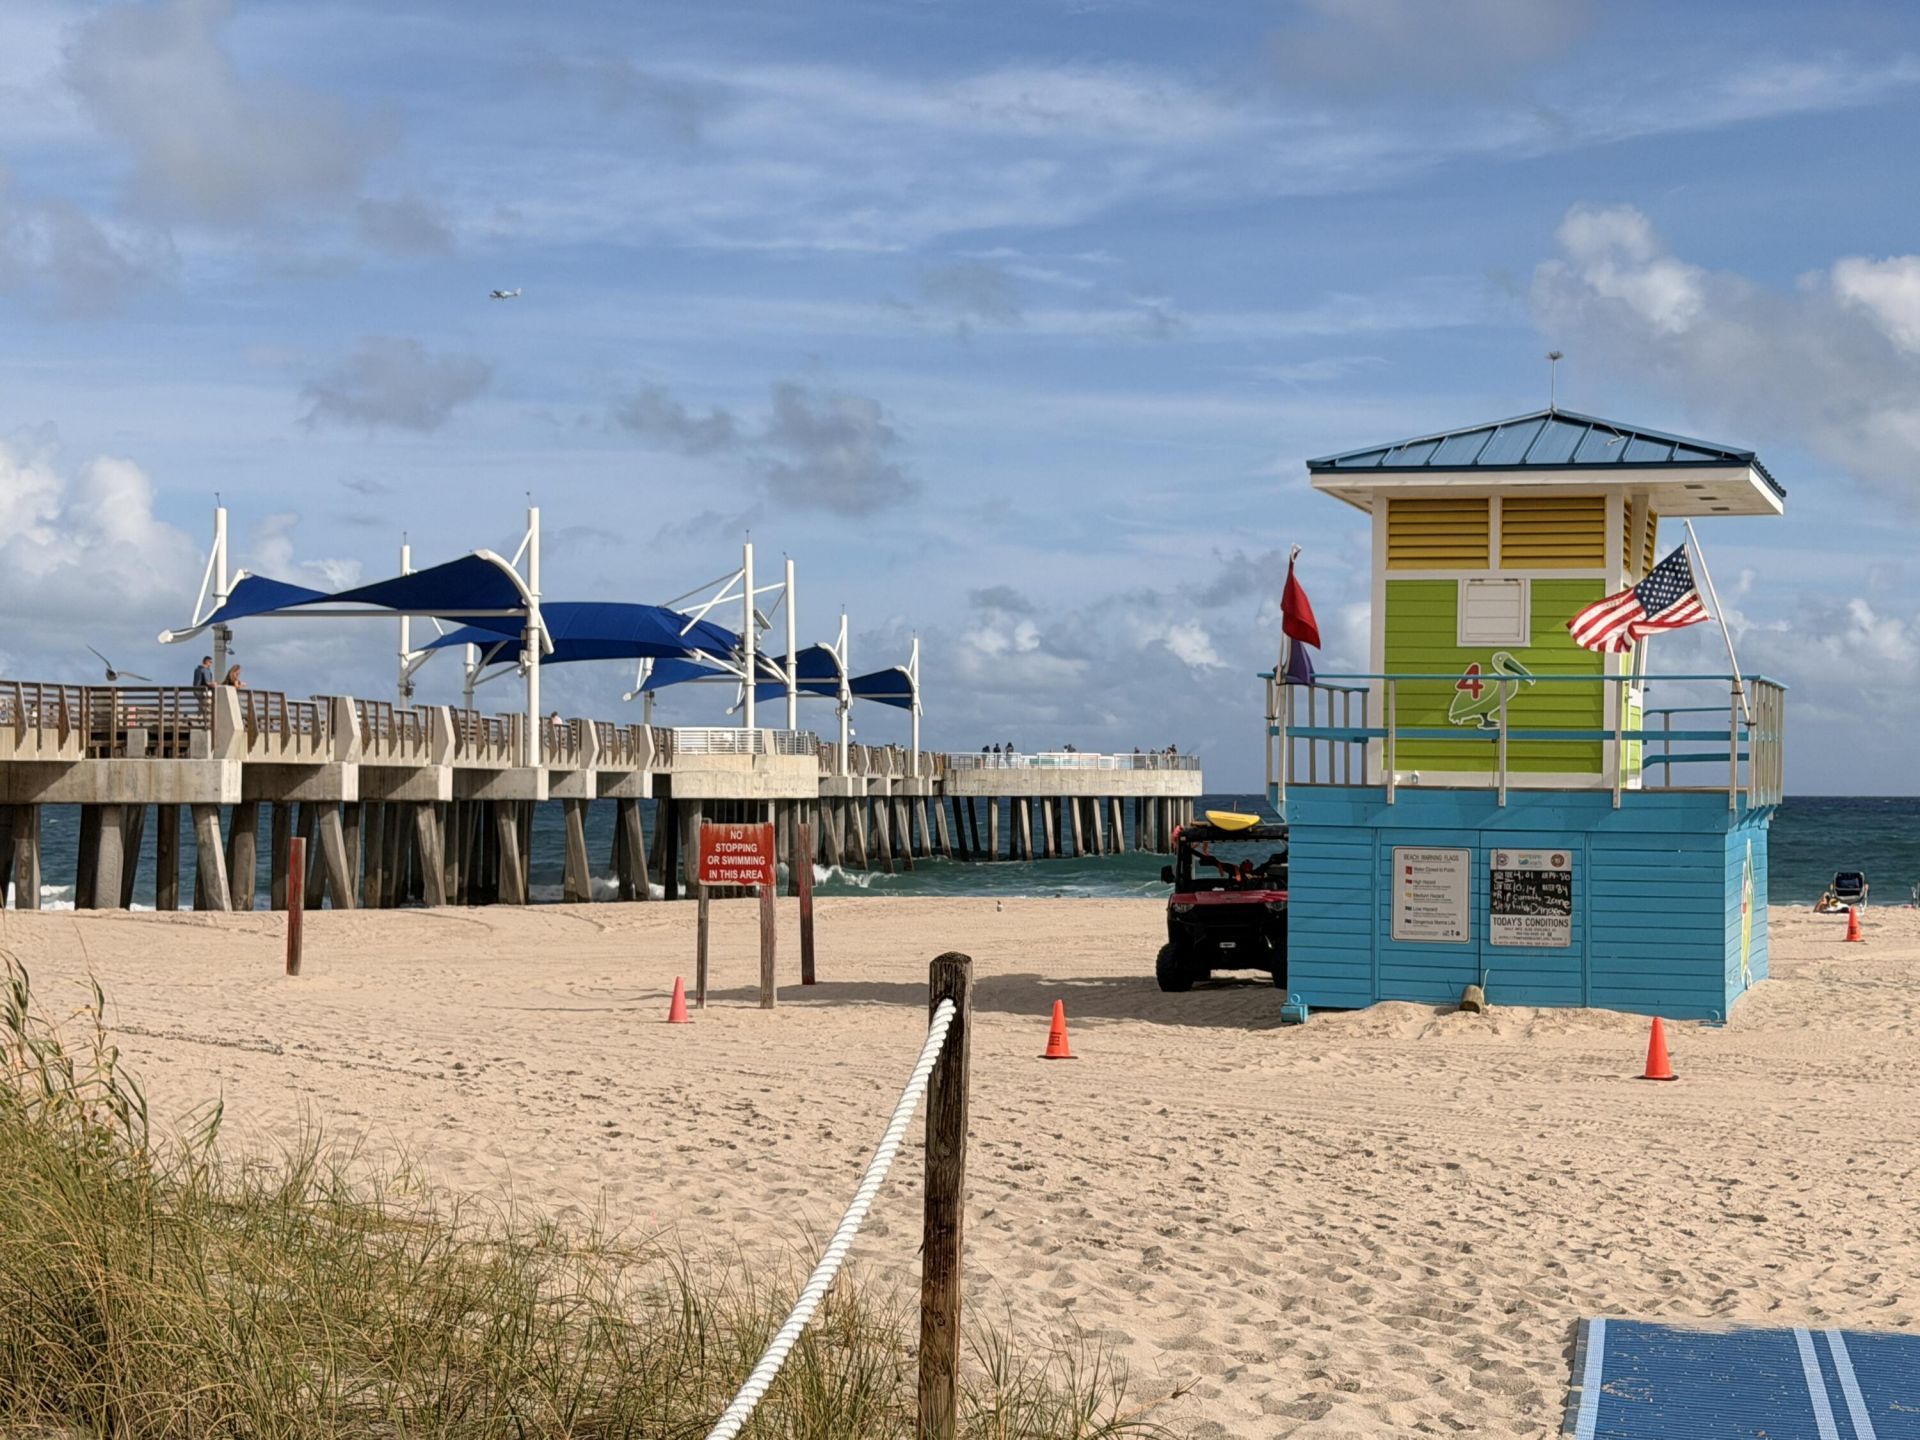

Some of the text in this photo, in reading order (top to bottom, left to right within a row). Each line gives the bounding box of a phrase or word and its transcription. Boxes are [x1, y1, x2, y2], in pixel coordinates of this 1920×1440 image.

[1455, 662, 1485, 701] 4
[730, 830, 742, 840] NO
[715, 842, 757, 852] STOPPING
[707, 856, 766, 865] OR SWIMMING
[709, 869, 763, 879] IN THIS AREA
[1493, 917, 1569, 927] TODAY'S CONDITIONS
